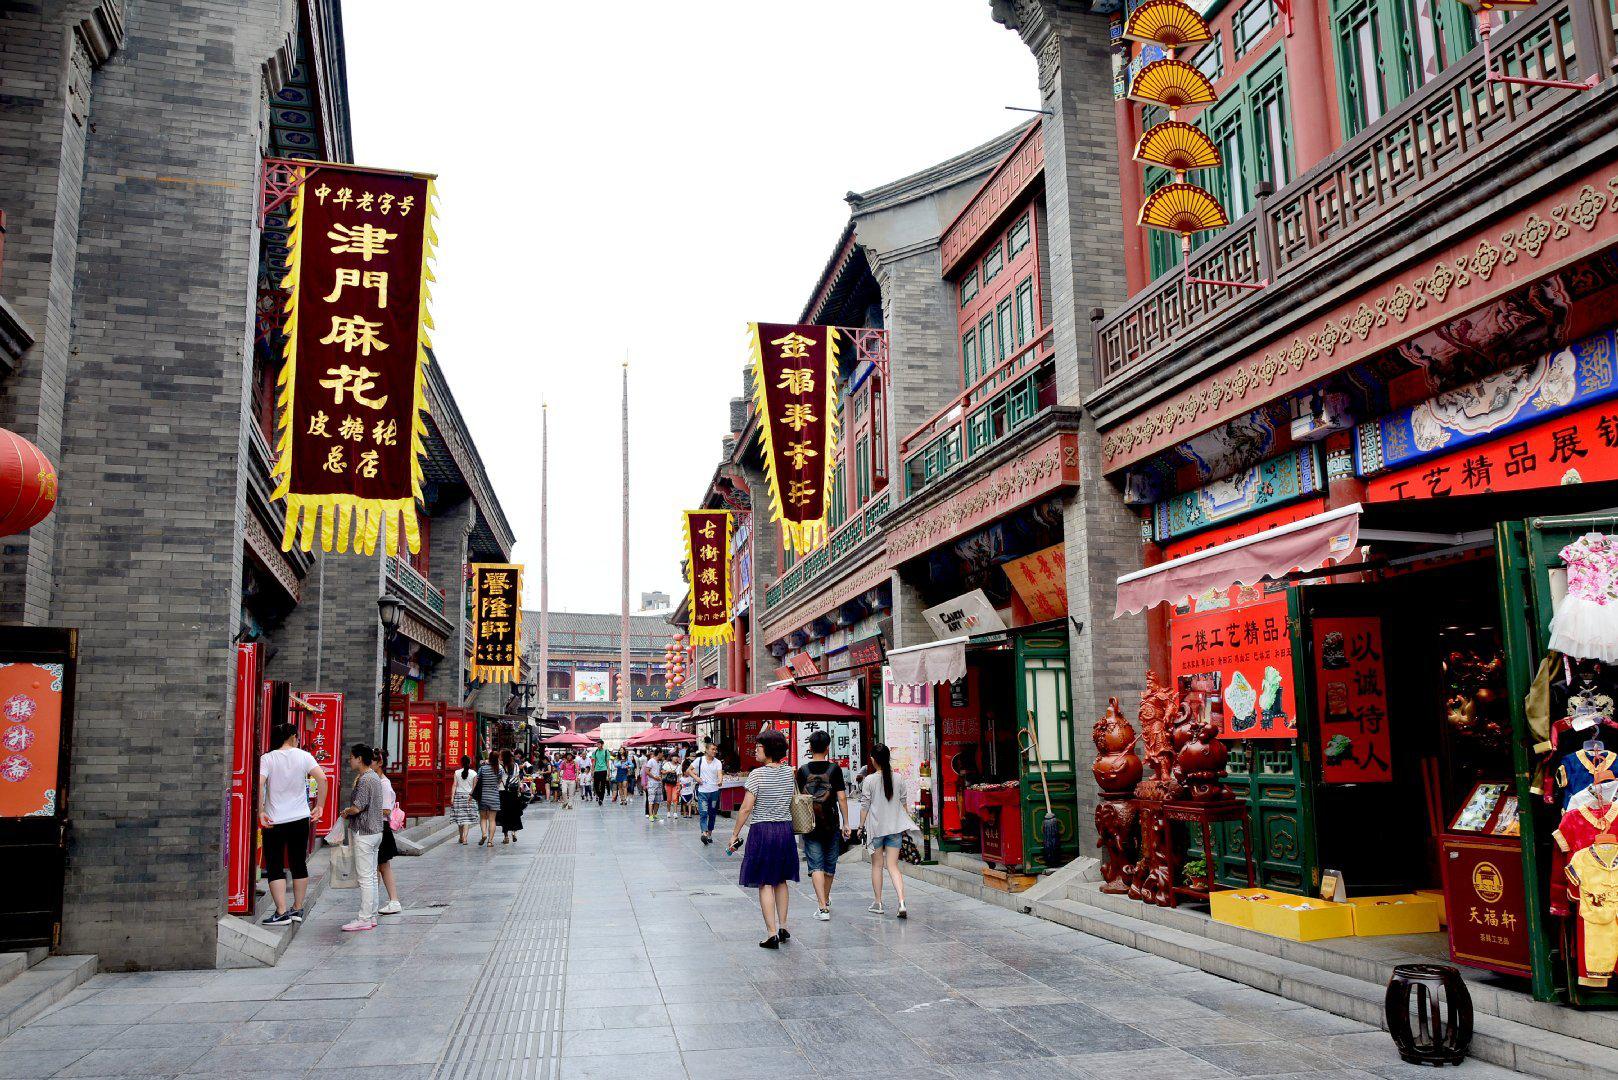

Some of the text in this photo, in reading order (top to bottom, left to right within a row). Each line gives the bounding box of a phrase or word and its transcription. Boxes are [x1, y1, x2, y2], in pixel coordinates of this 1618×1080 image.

[314, 182, 415, 217] 中华老字号
[318, 222, 399, 410] 津門麻花
[322, 445, 380, 479] 总店
[1350, 630, 1389, 772] 以诚待人
[5, 699, 32, 778] 联升斋
[1469, 906, 1517, 932] 天福轩
